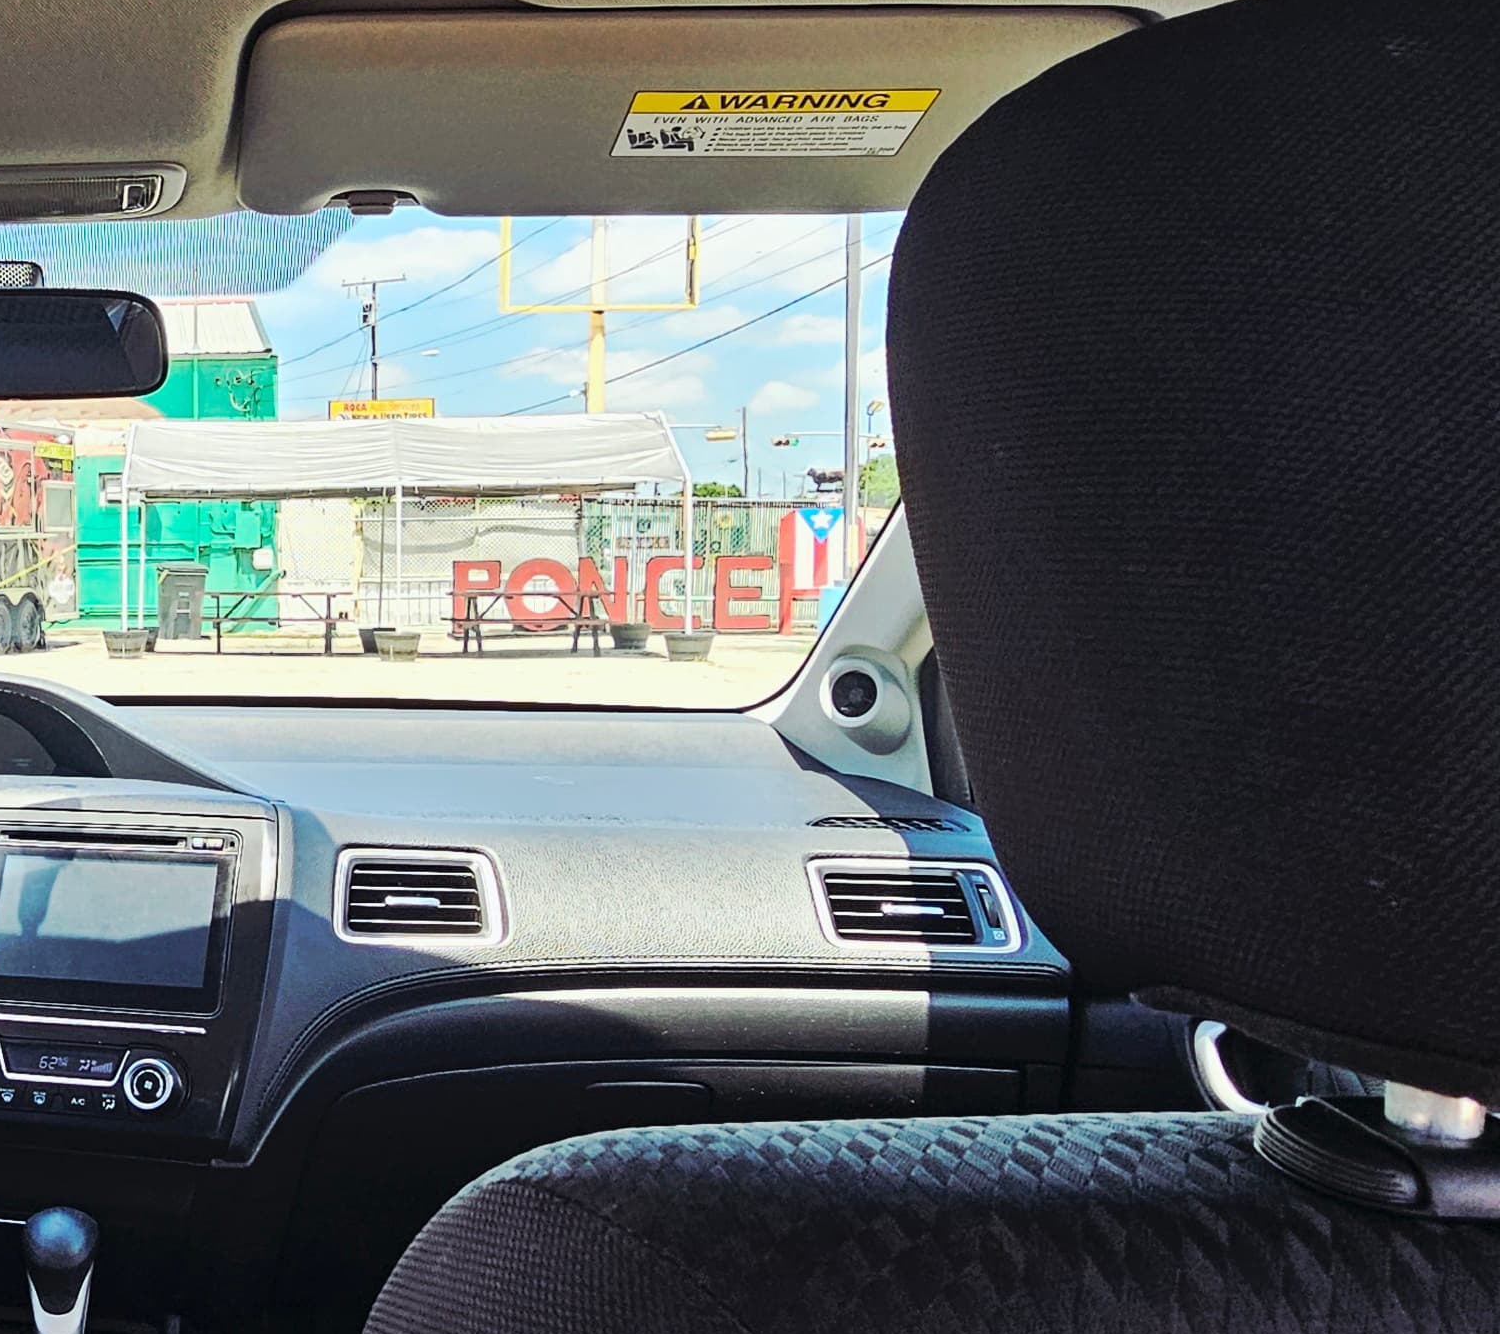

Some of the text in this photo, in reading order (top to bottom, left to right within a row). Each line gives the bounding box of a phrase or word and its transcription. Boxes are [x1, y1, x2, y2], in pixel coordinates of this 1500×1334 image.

[719, 93, 891, 110] WARNING
[653, 115, 880, 124] EVEN WITH ADVANCED AIR BAGS
[453, 555, 773, 634] PONCE
[70, 1097, 85, 1106] A/C
